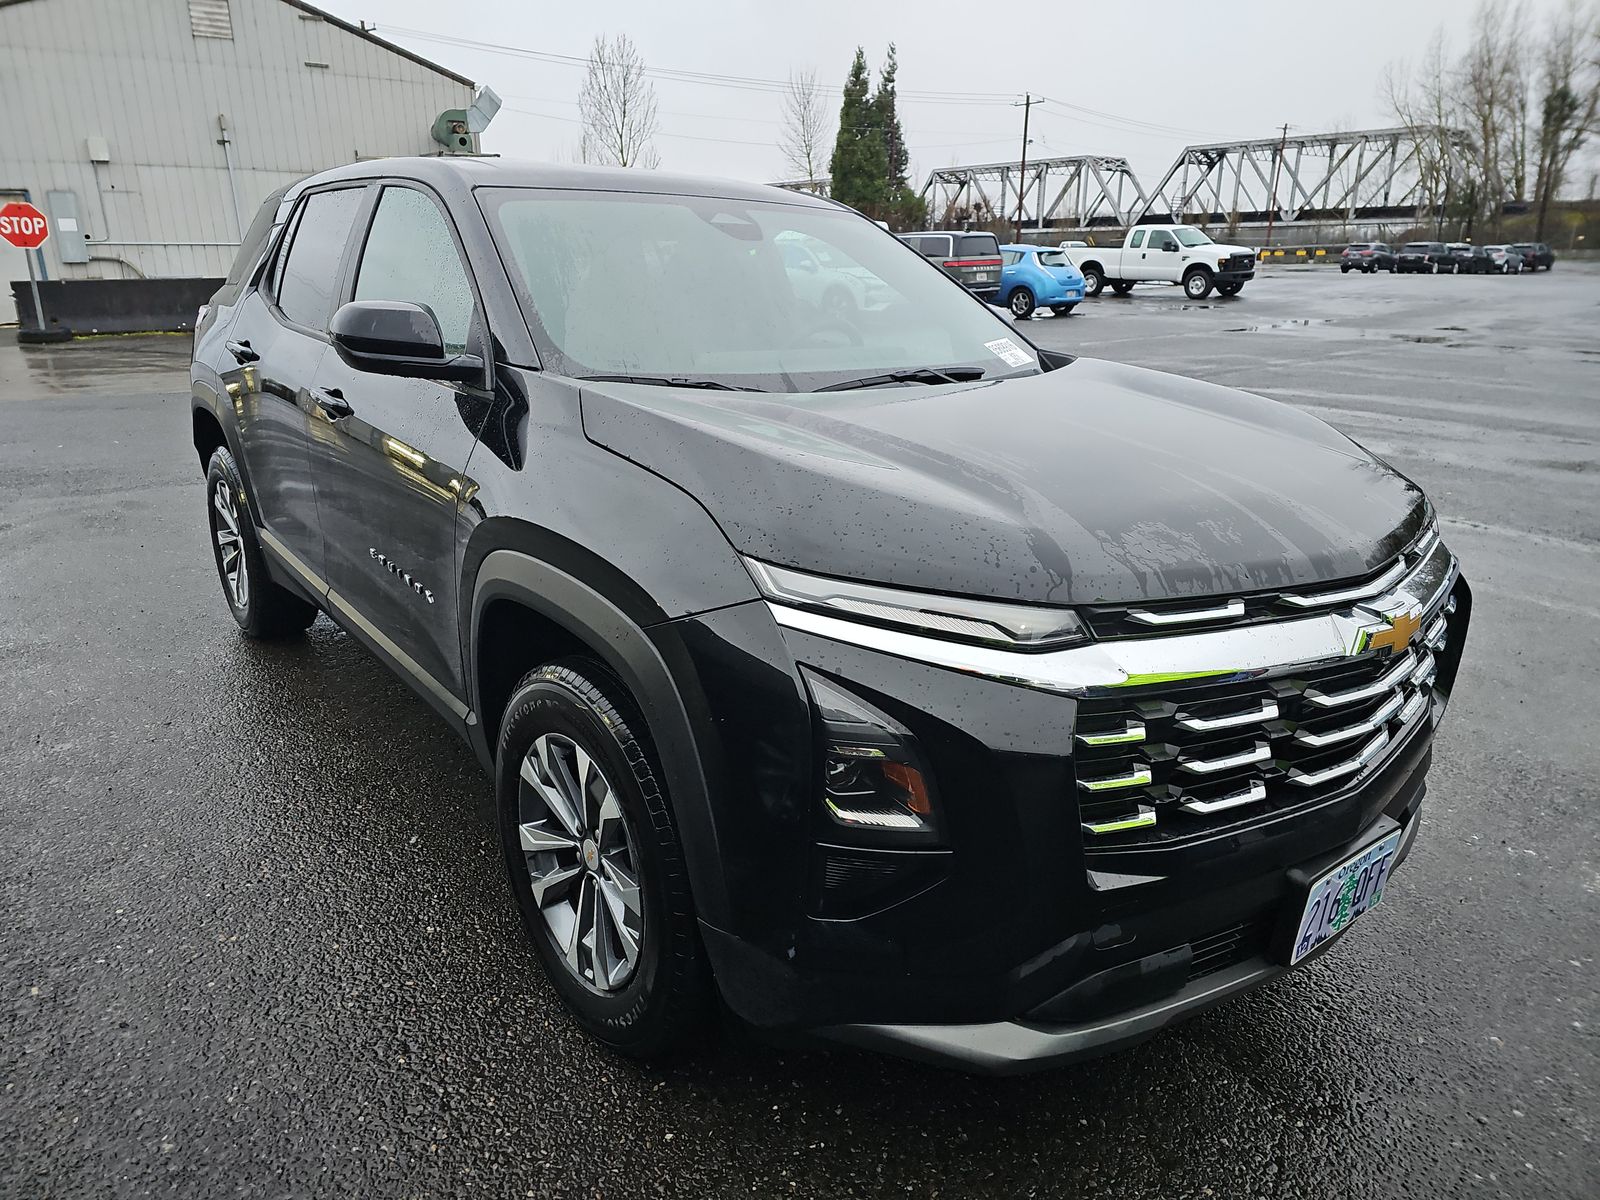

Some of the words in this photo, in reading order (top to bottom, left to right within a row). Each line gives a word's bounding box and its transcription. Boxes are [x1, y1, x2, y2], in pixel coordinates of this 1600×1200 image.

[0, 216, 45, 235] STOP
[502, 698, 543, 750] Firestone
[1338, 850, 1373, 880] Oregon
[1302, 882, 1345, 944] 216
[1351, 850, 1394, 908] QFF
